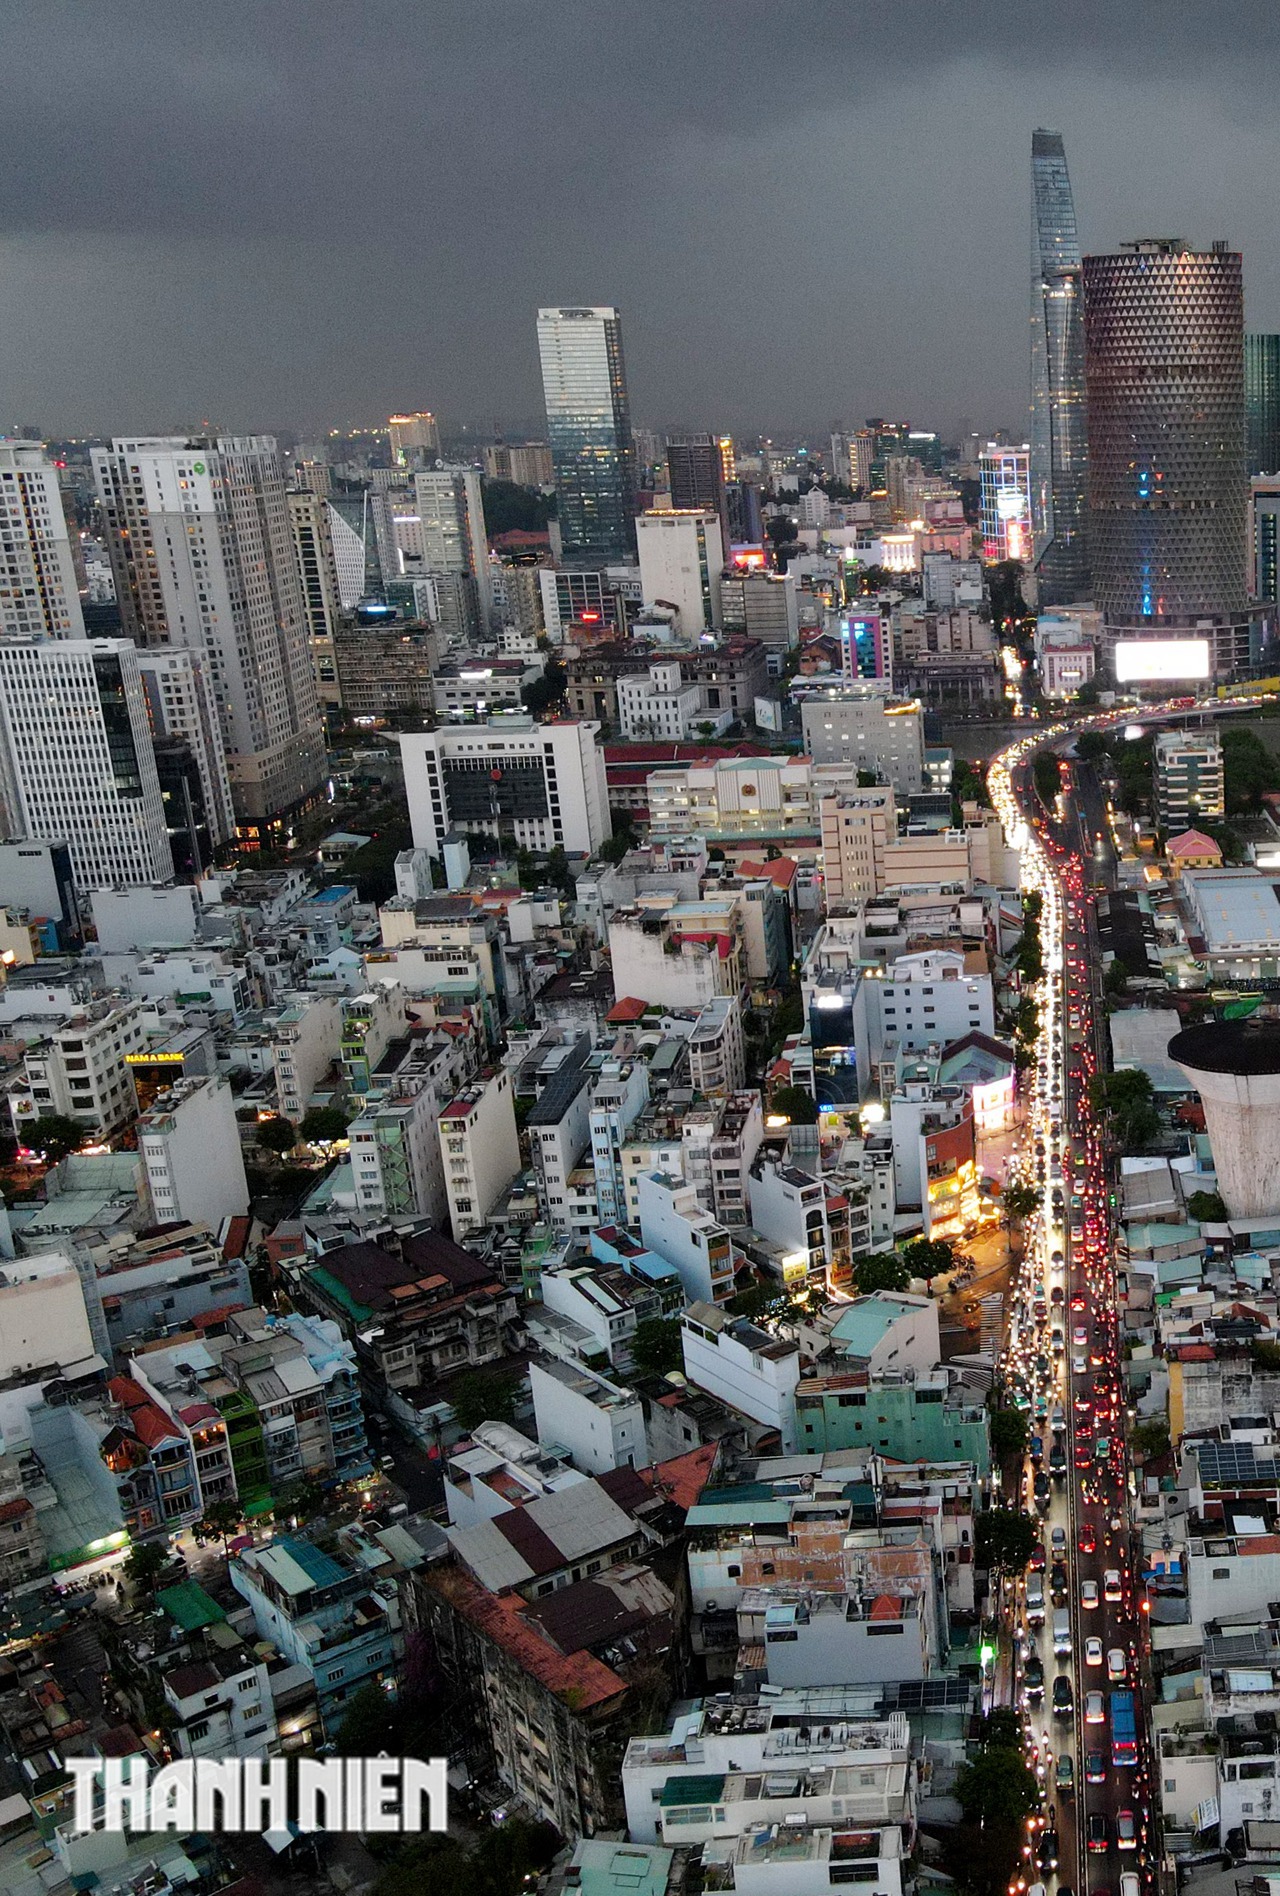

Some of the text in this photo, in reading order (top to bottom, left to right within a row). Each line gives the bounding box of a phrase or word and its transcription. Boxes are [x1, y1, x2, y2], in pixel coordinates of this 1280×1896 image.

[125, 1053, 185, 1062] NAM A BANK
